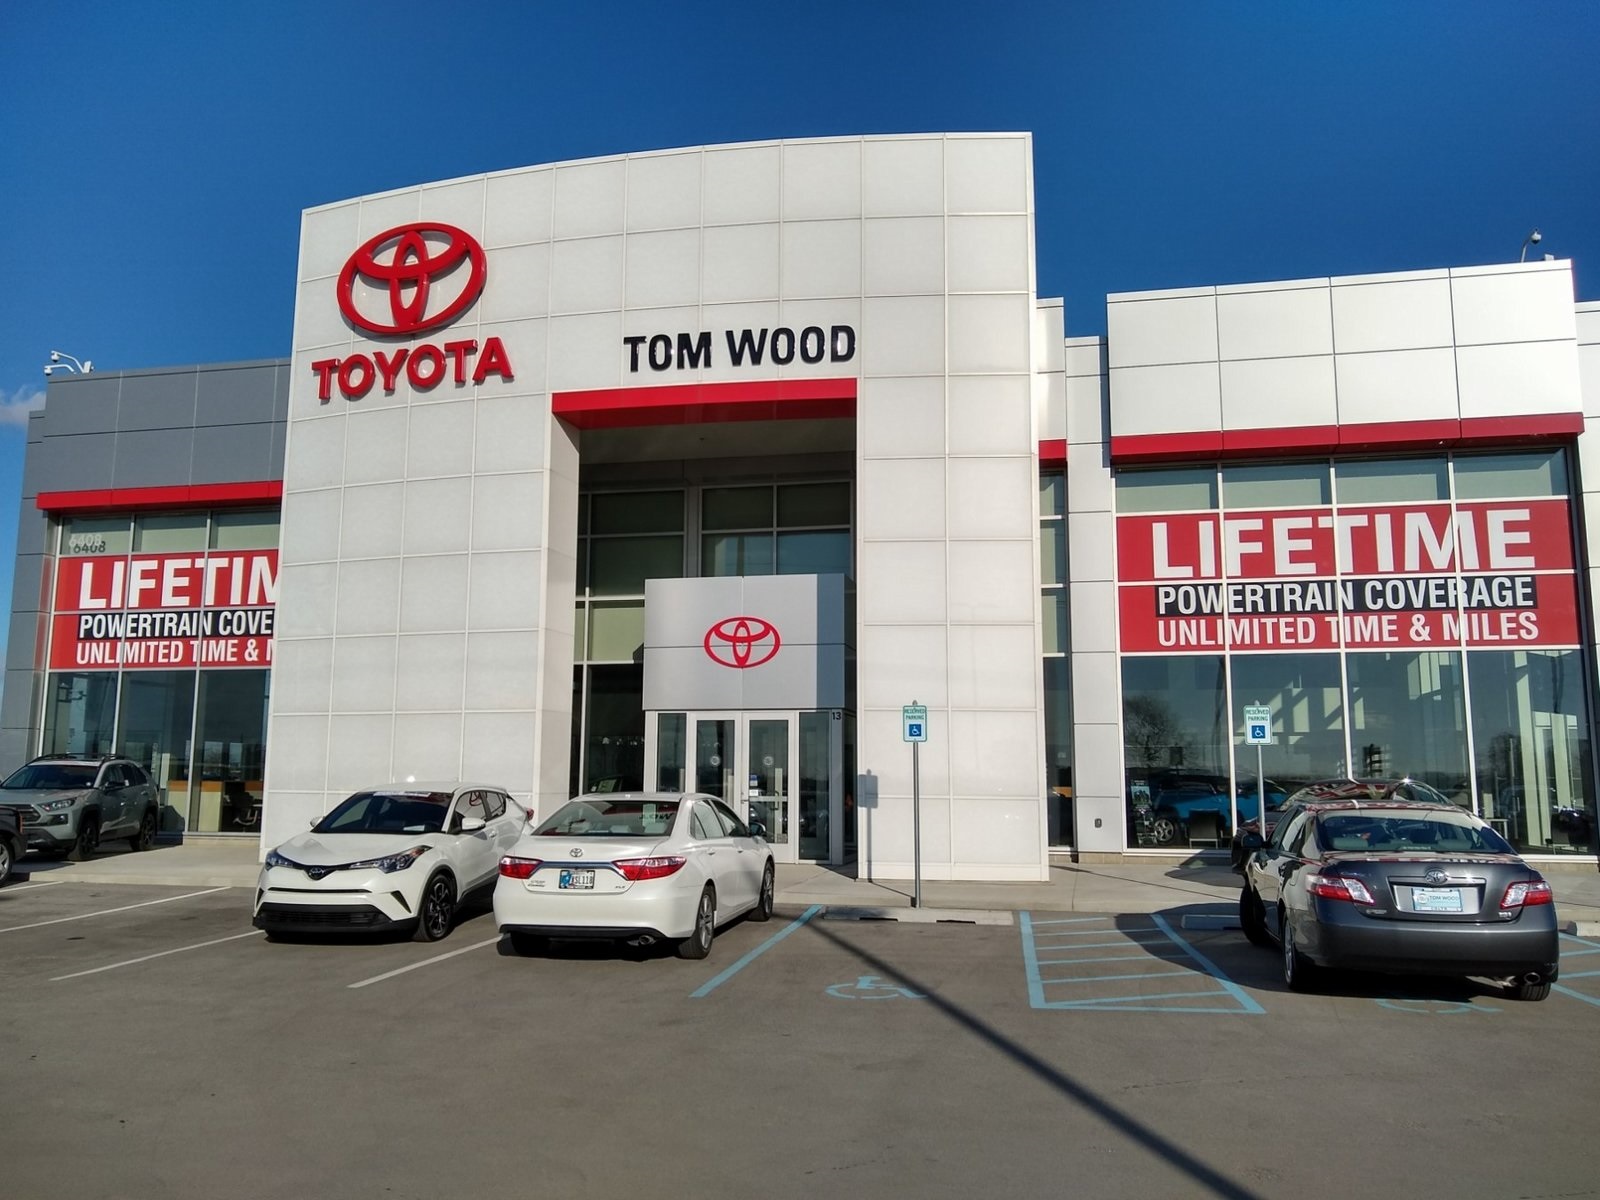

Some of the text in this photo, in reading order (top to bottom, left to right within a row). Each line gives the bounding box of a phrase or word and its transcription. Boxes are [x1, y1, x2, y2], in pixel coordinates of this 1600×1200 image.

[623, 325, 856, 373] TOM WOOD
[311, 337, 514, 401] TOYOTA
[1152, 508, 1536, 578] LIFETIME
[79, 556, 278, 609] LIFETIM
[1158, 577, 1534, 615] POWERTRAIN COVERAGE
[79, 610, 273, 639] POWERTRAIN COVE
[1158, 612, 1539, 647] UNLIMITED TIME & MILES
[76, 640, 184, 665] UNLIMITED
[189, 640, 239, 663] TIME
[244, 639, 260, 662] &
[832, 711, 842, 721] 13
